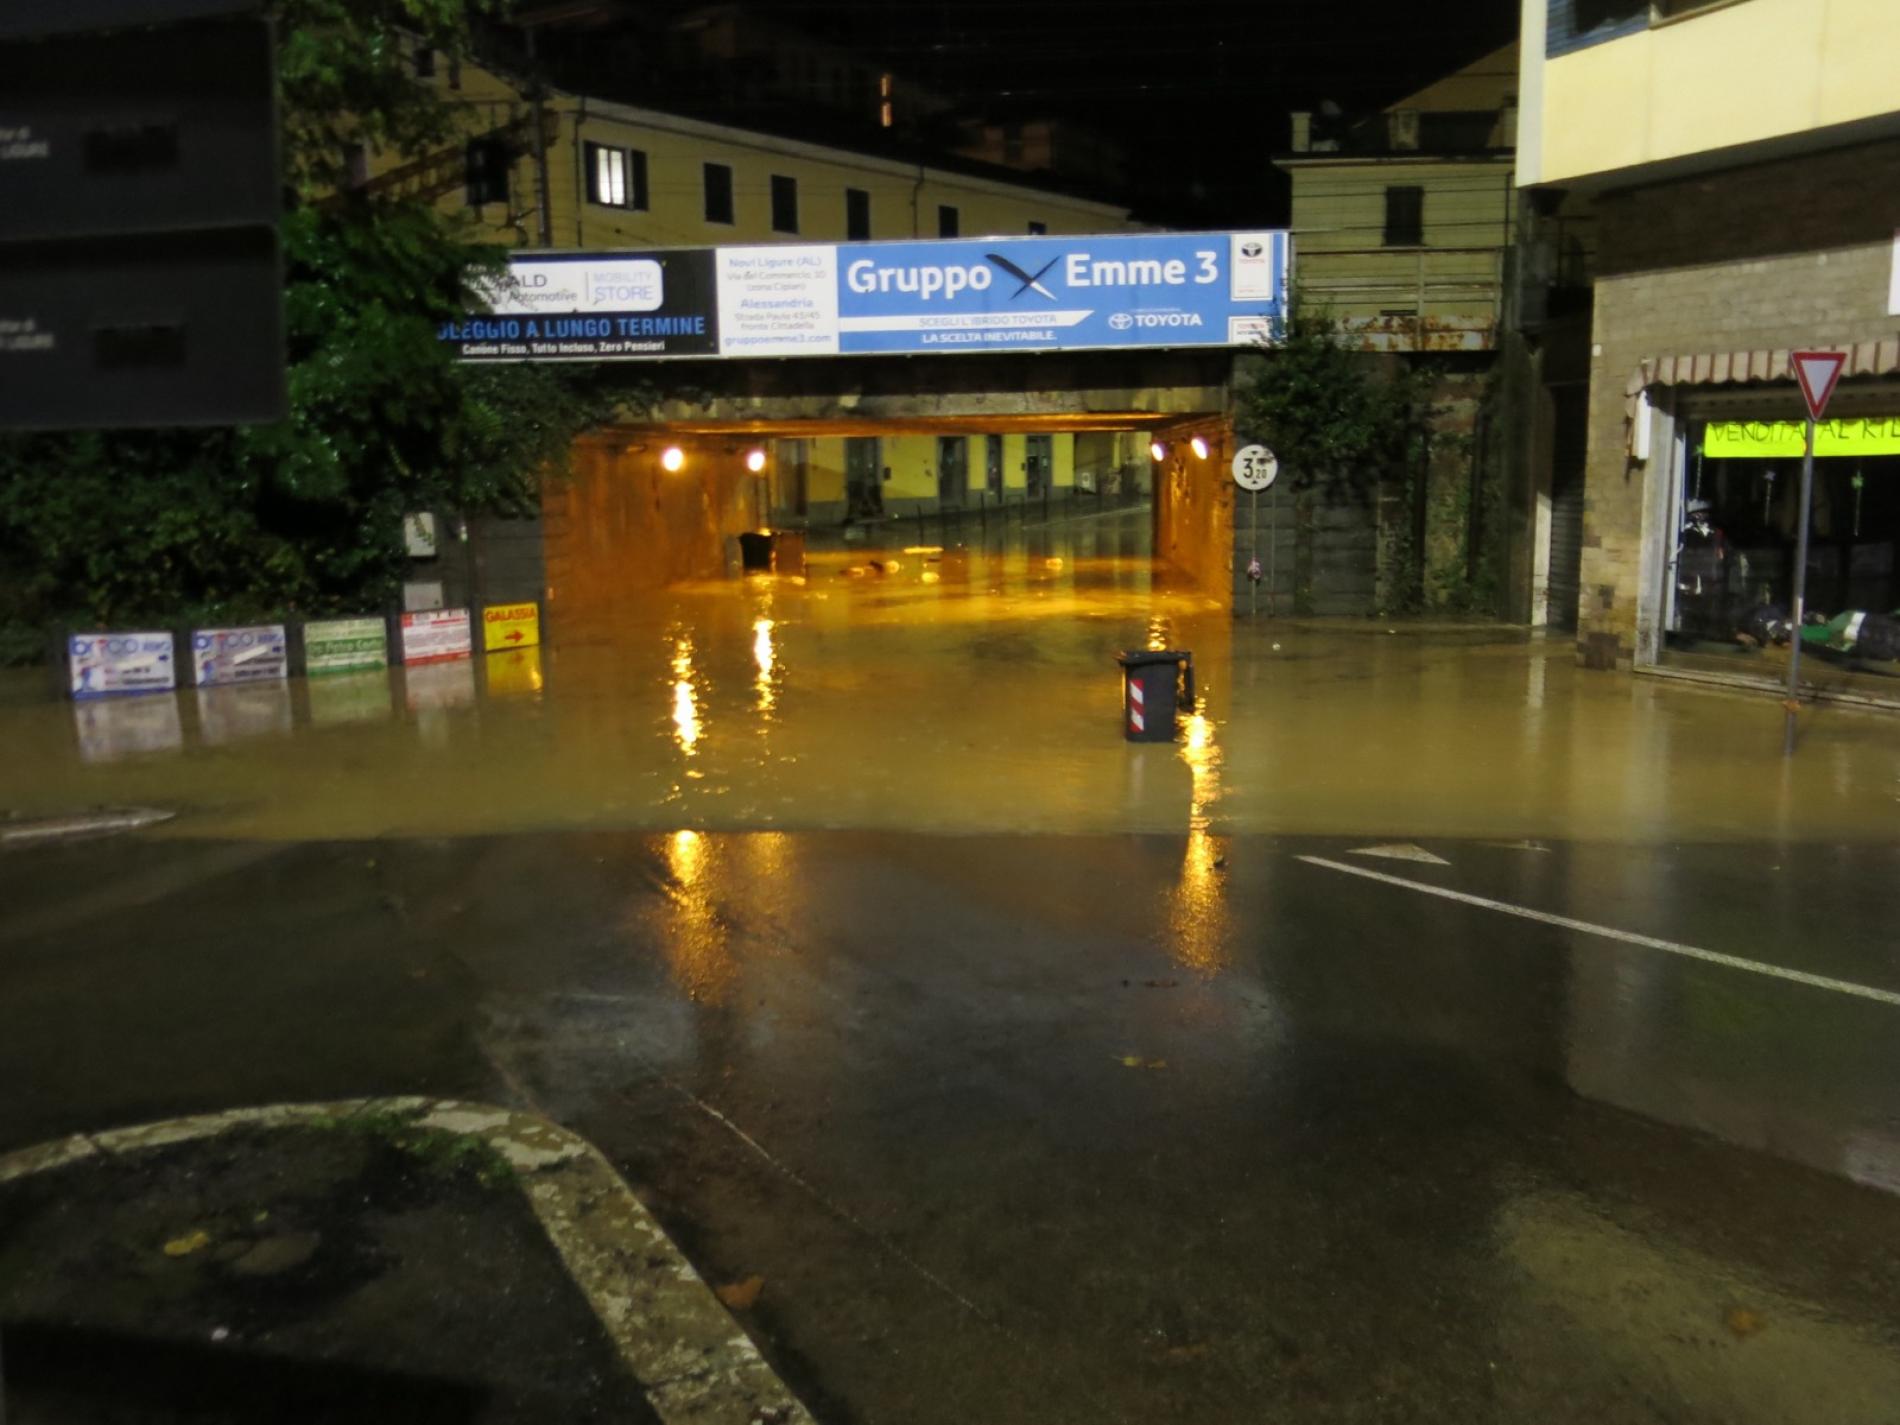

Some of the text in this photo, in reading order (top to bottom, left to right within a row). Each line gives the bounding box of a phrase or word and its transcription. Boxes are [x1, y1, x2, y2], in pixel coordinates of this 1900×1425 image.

[847, 251, 1218, 300] Gruppo Emme 3
[594, 285, 654, 301] STORE
[526, 320, 539, 338] A
[544, 318, 612, 338] LUNGO
[618, 316, 706, 337] TERMINE
[1009, 314, 1057, 325] TOYOTA
[1134, 313, 1203, 328] TOYOTA
[922, 334, 937, 344] LA
[937, 332, 982, 343] SCELTA
[1819, 419, 1849, 440] AL
